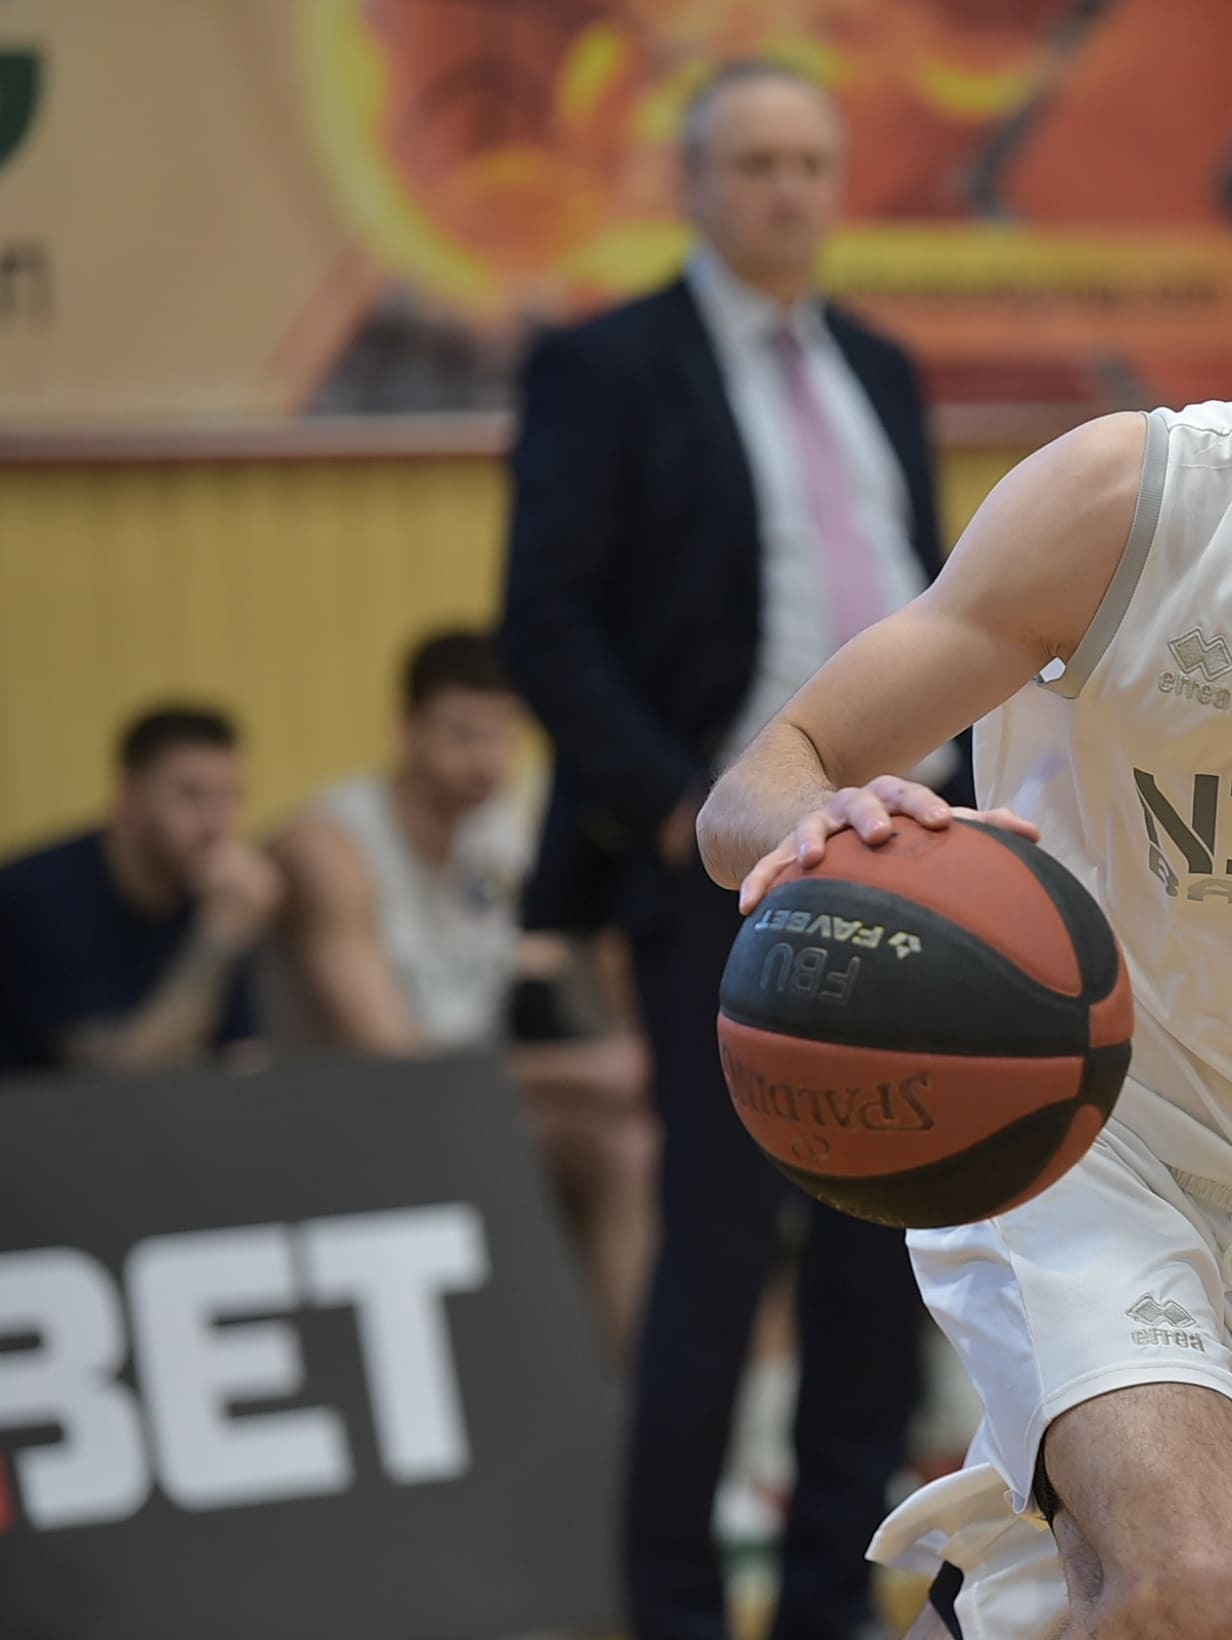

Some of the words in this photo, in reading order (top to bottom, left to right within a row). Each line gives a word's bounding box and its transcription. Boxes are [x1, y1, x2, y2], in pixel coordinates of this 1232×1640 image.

[754, 908, 885, 949] FAVBET
[760, 942, 862, 1006] FBU
[0, 1200, 490, 1533] BET
